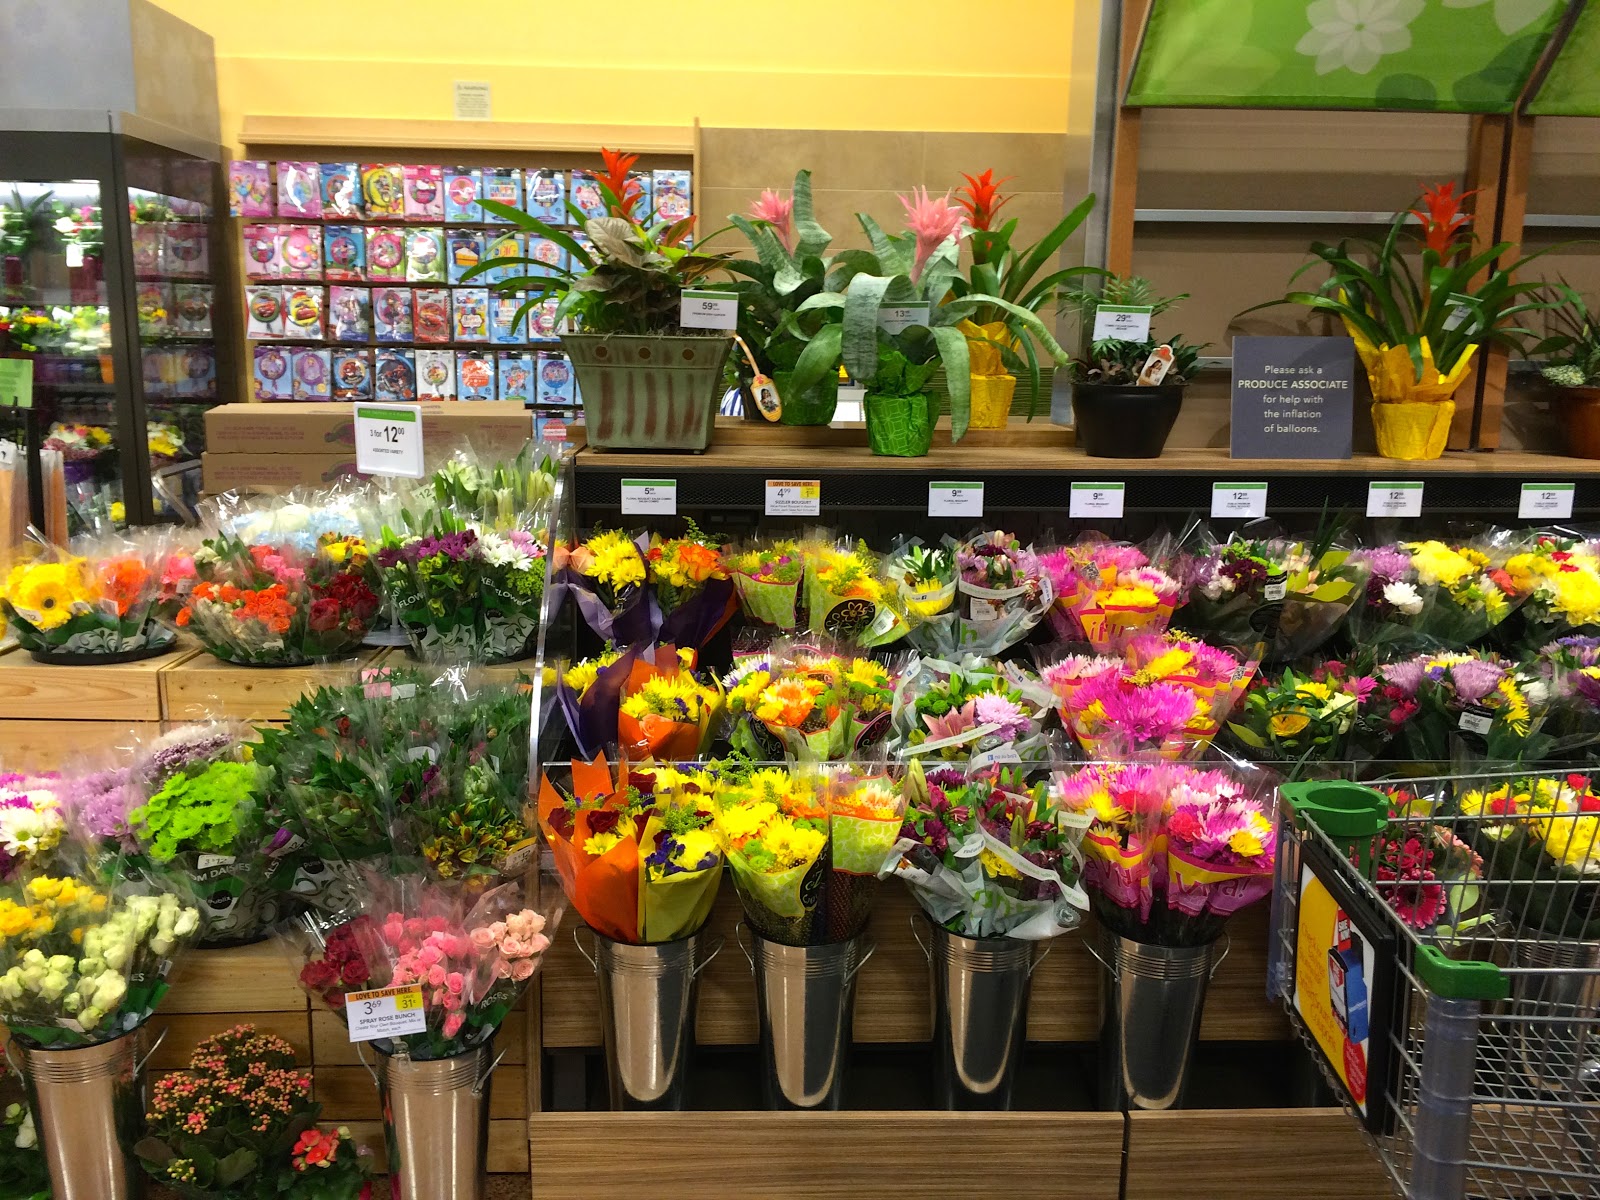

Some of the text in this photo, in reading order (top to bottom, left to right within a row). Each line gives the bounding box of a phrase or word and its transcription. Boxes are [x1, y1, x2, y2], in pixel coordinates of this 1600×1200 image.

[702, 302, 713, 310] 59
[1116, 314, 1126, 322] 29
[1264, 365, 1296, 374] Please
[1298, 366, 1314, 374] ask
[1238, 380, 1348, 389] PRODUCE ASSOCIATE
[1262, 394, 1324, 406] for help with
[1264, 409, 1322, 418] the inflation
[1264, 424, 1320, 433] of balloons.
[370, 429, 374, 437] 3
[374, 430, 382, 438] for
[384, 425, 398, 443] 12
[777, 488, 784, 498] 4
[1232, 492, 1242, 500] 12
[1389, 492, 1399, 500] 12
[1541, 492, 1551, 500] 12
[355, 990, 370, 1000] LOVE
[380, 989, 395, 997] SAVE
[363, 1001, 373, 1015] 3
[360, 1017, 377, 1025] SPRAY
[394, 1012, 416, 1020] BUNCH
